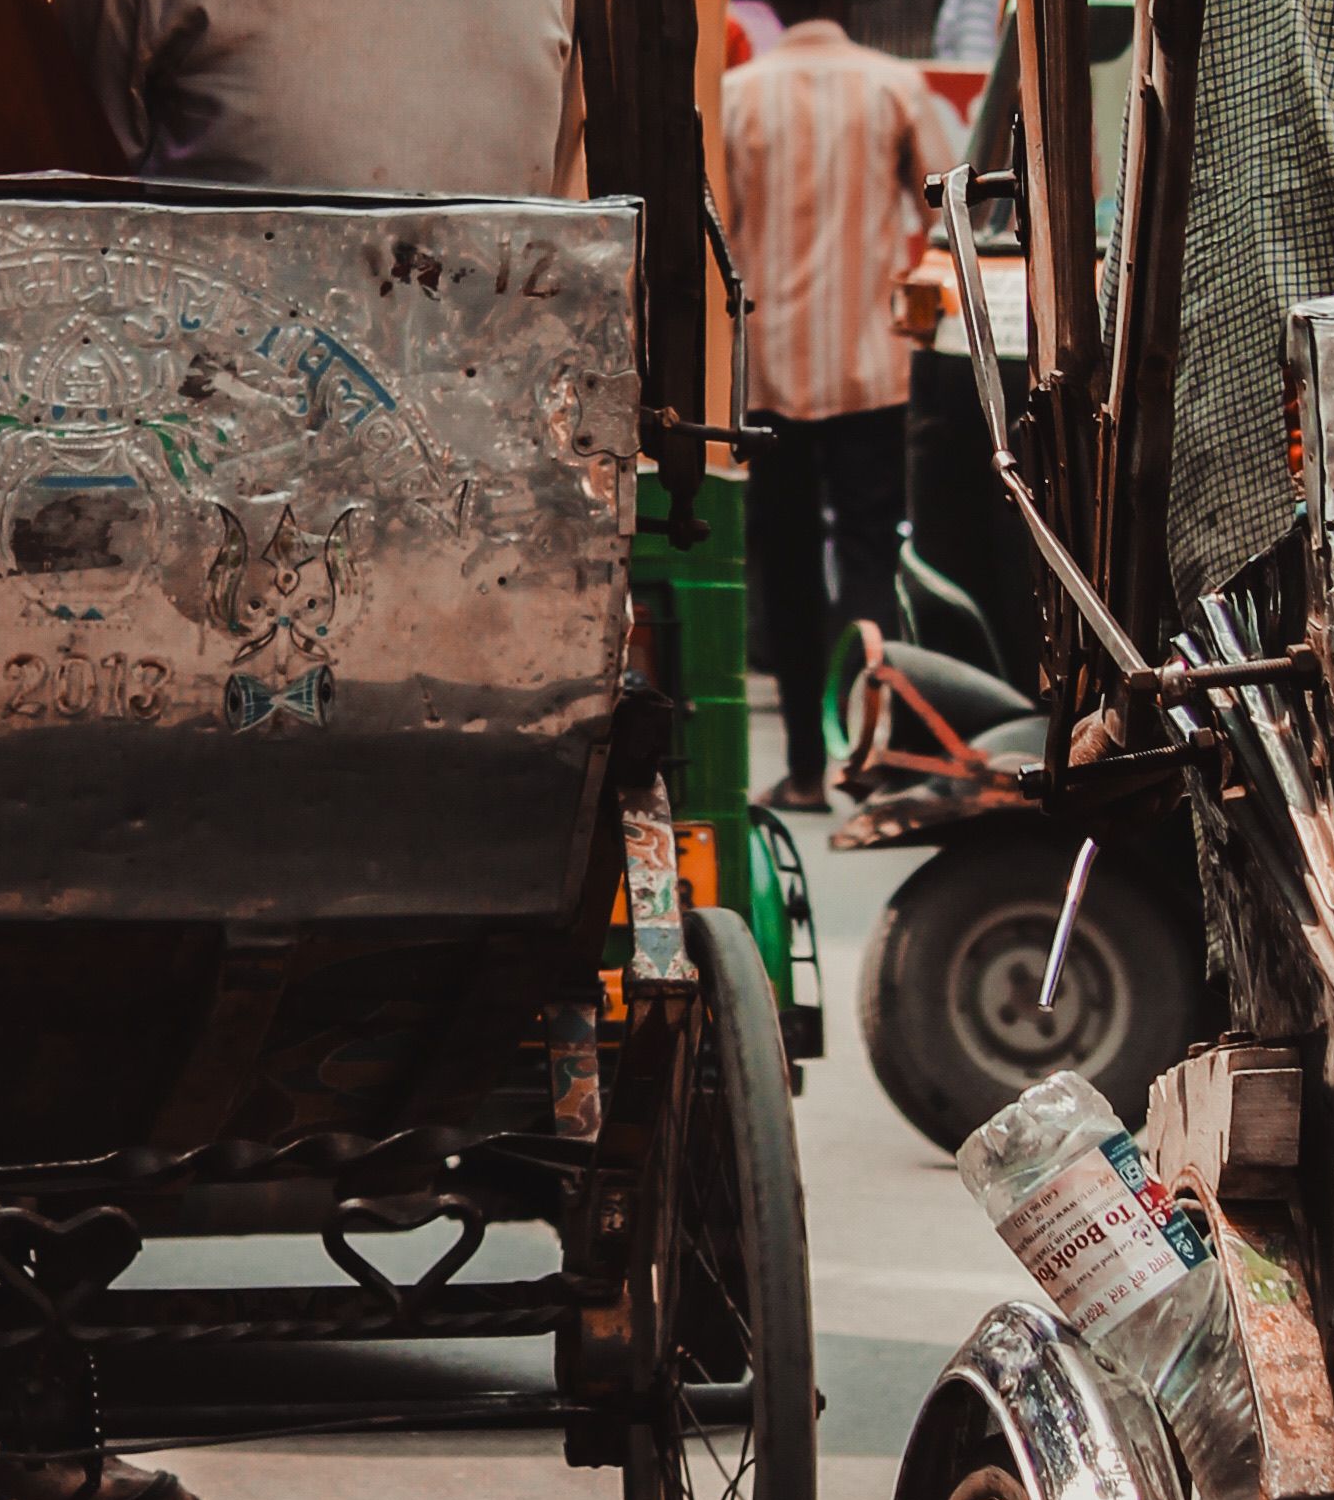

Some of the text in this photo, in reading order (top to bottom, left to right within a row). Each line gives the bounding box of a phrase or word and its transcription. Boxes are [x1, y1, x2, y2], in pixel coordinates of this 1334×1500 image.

[2, 650, 174, 723] 2013
[1102, 1200, 1136, 1232] To
[1049, 1221, 1108, 1273] Book
